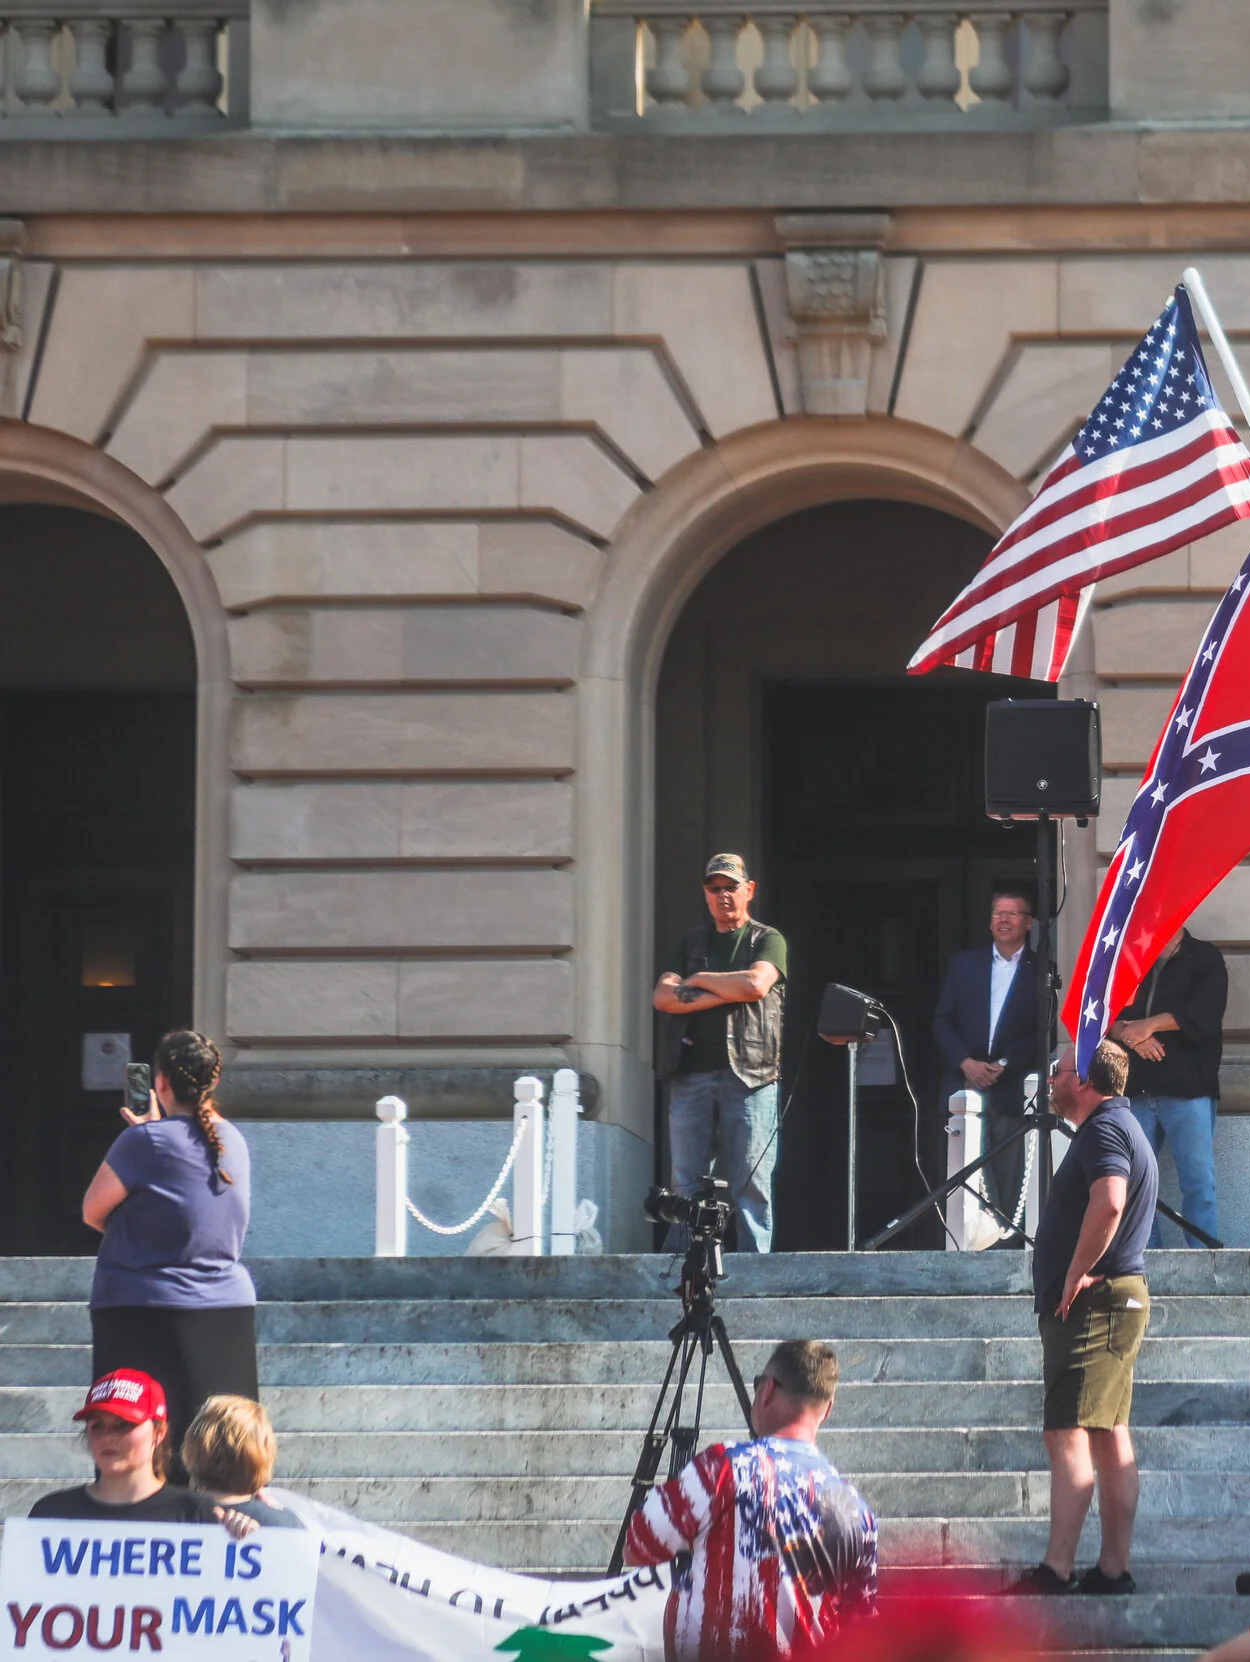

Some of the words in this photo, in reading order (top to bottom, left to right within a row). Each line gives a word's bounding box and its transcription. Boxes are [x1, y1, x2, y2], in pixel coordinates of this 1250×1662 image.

[41, 1537, 203, 1577] WHERE
[224, 1541, 262, 1579] IS
[7, 1602, 163, 1653] YOUR
[171, 1596, 307, 1637] MASK
